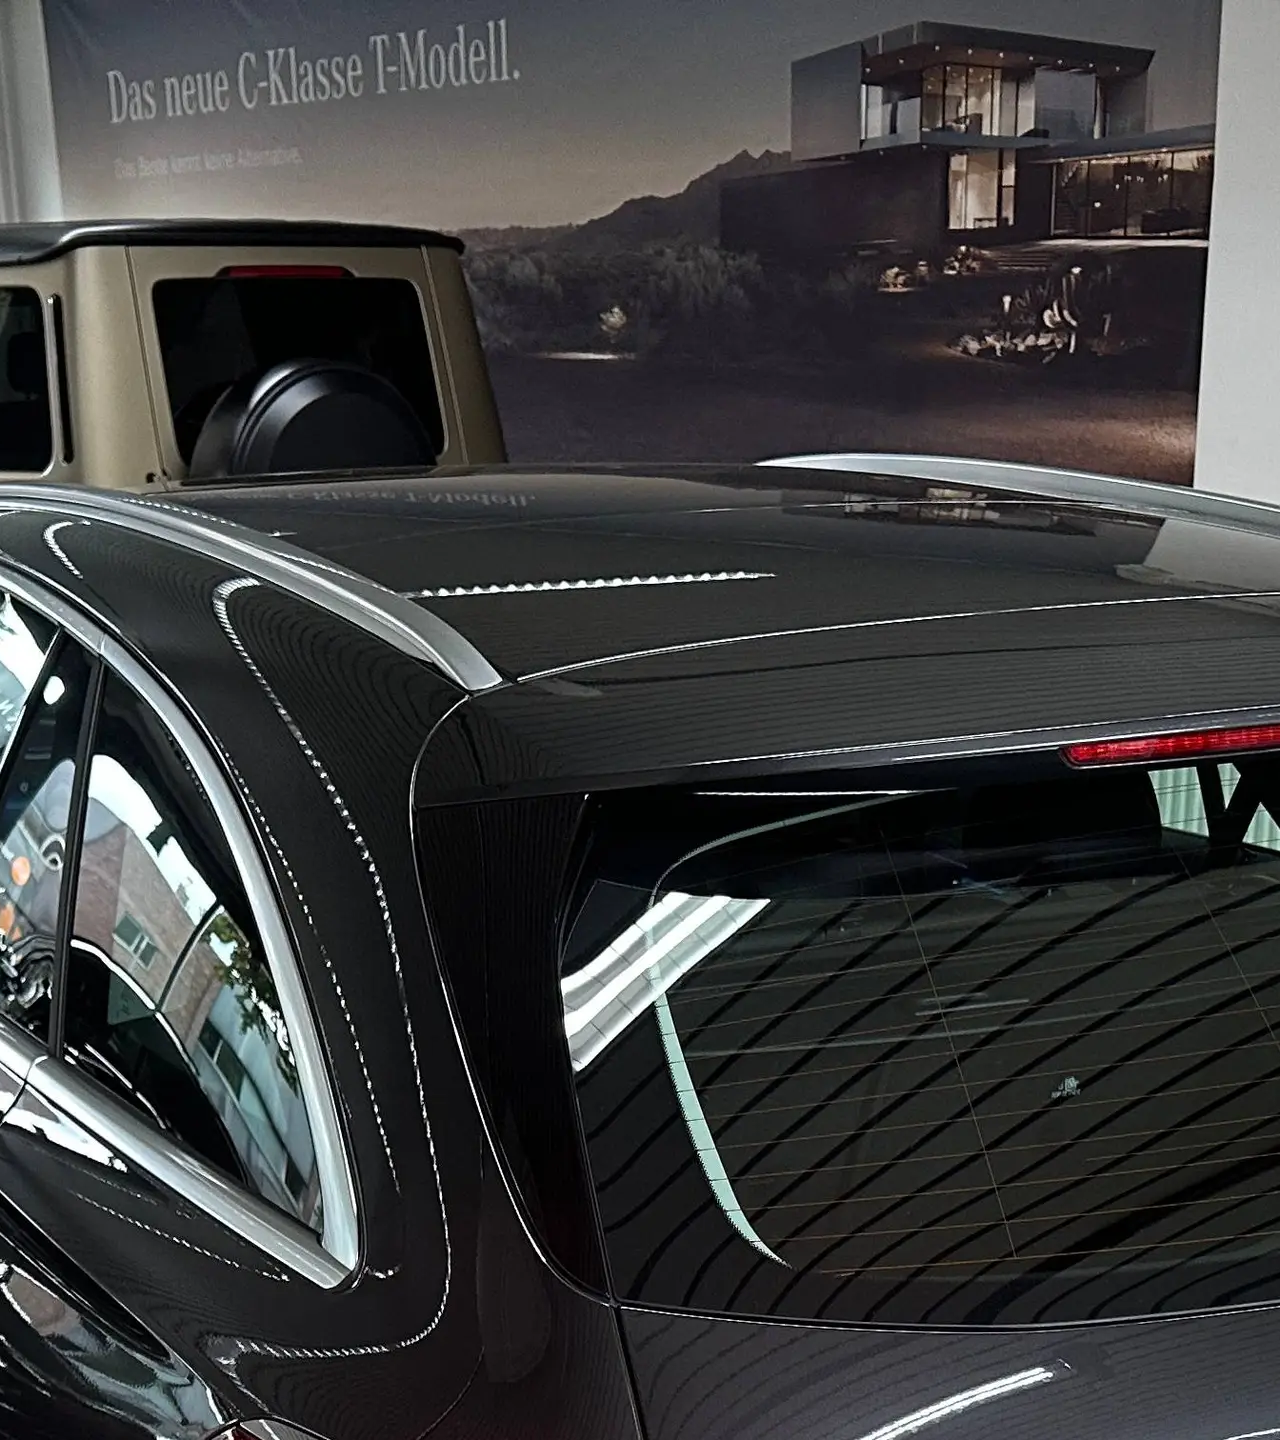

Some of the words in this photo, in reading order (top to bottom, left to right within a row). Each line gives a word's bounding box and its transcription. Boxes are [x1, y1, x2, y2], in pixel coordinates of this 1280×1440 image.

[106, 69, 157, 124] Das
[163, 68, 231, 118] neue
[238, 46, 364, 110] C-Klasse
[369, 18, 520, 95] T-Modell.
